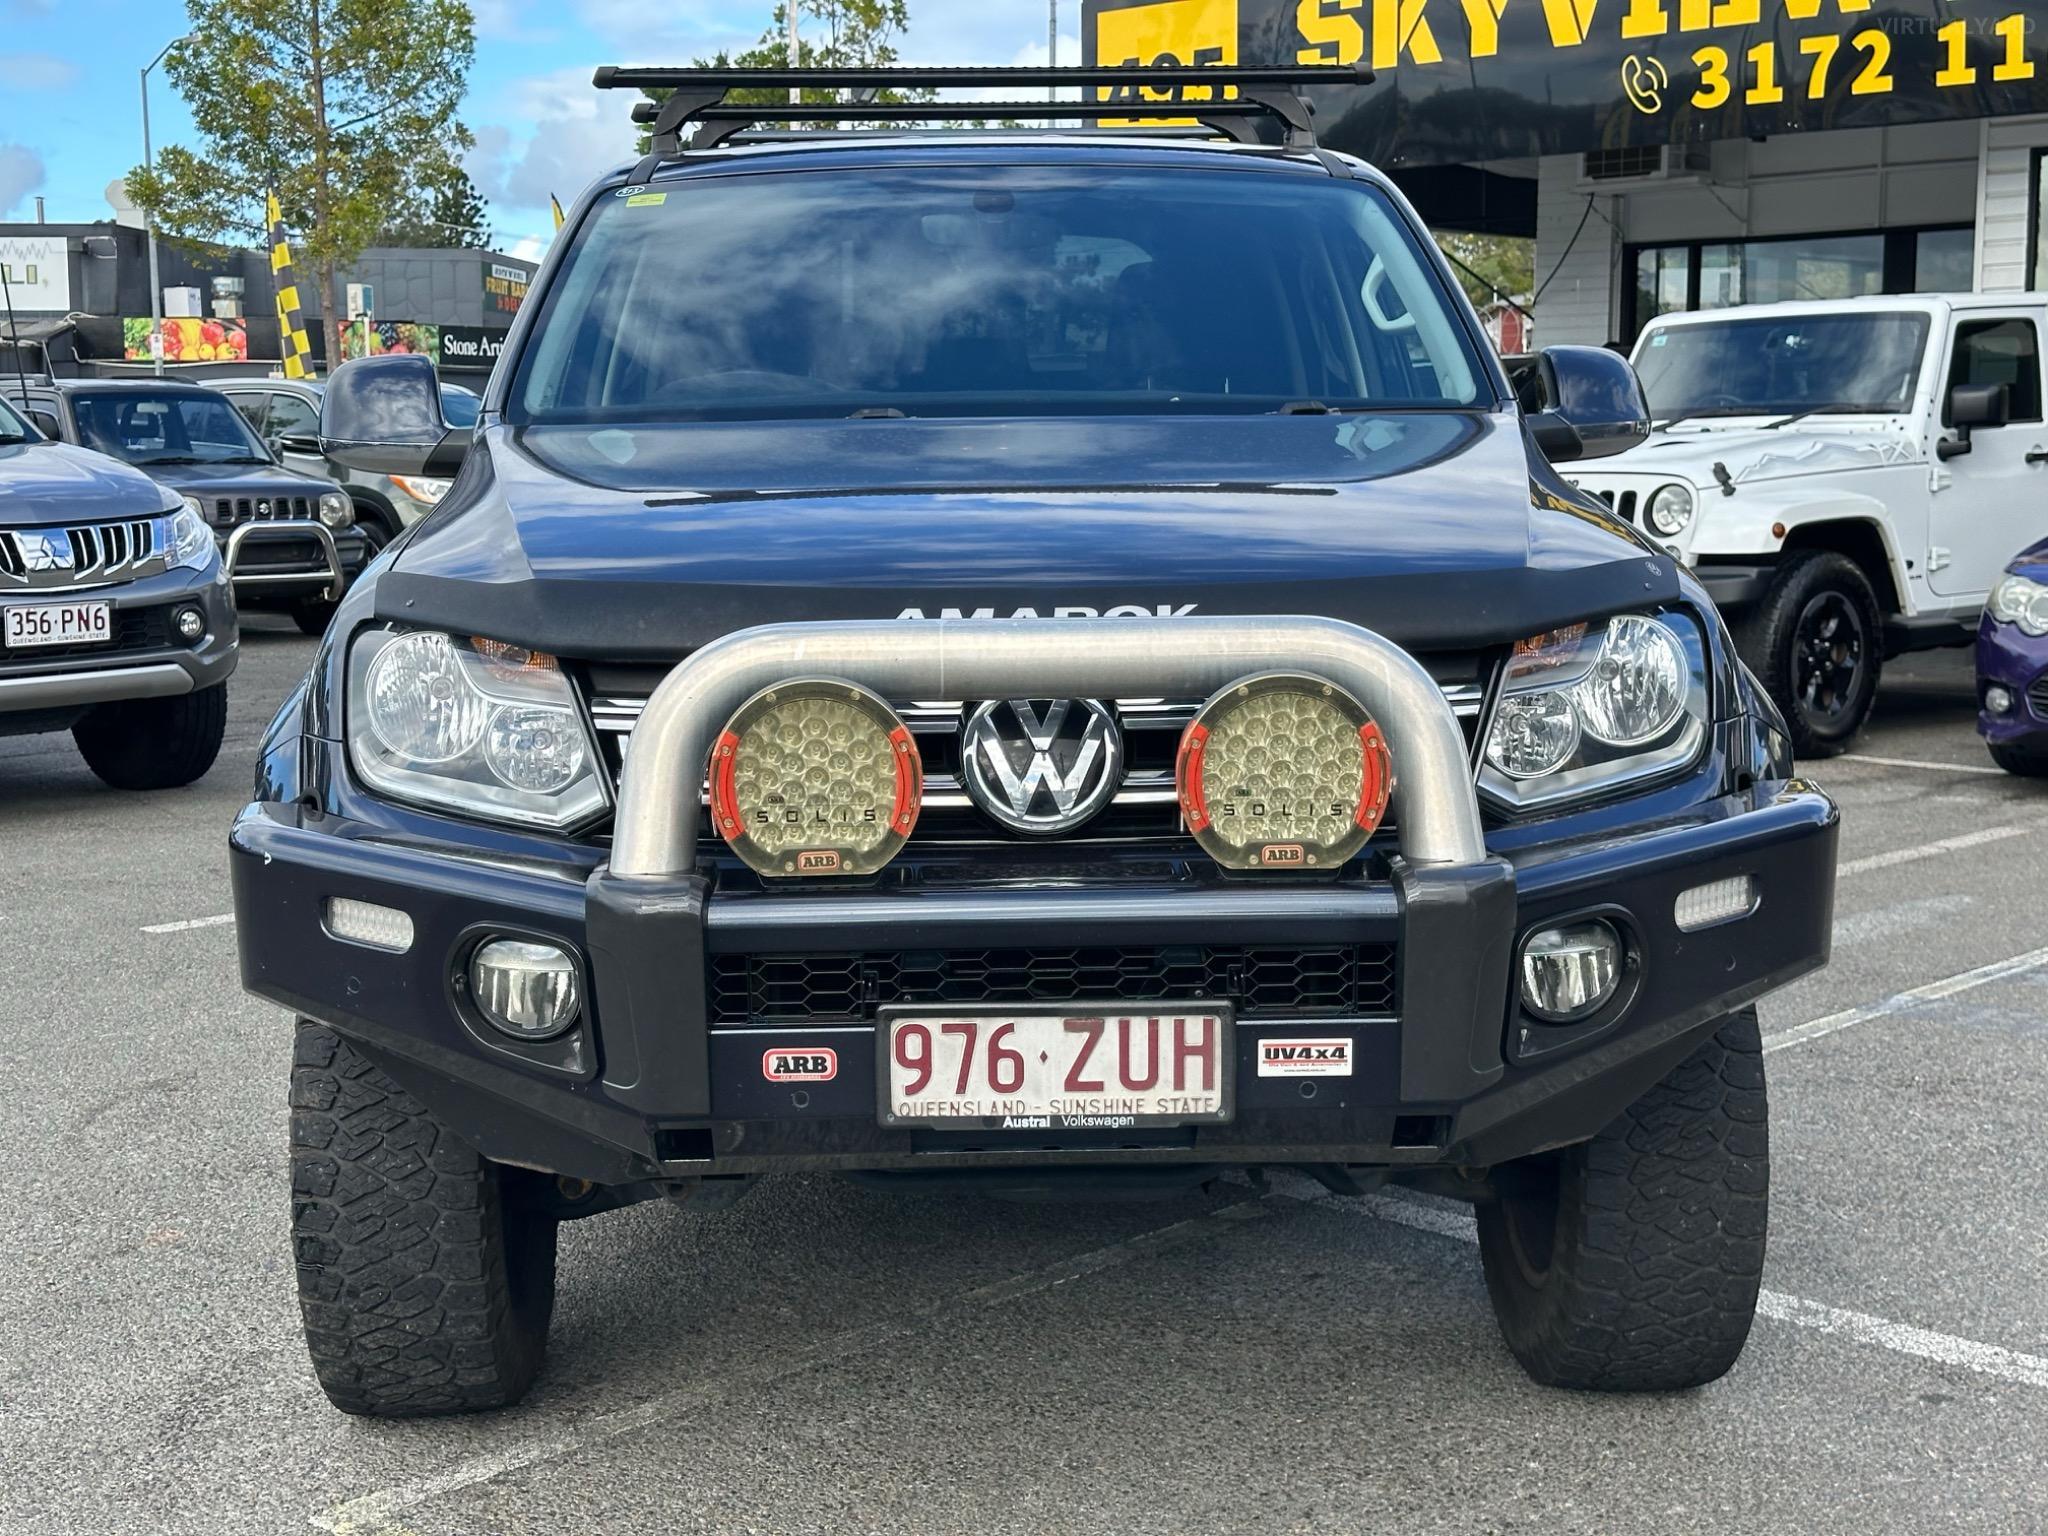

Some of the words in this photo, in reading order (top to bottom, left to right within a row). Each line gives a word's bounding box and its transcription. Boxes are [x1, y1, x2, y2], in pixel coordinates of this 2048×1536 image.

[1296, 0, 1873, 70] SKYVI
[1690, 29, 1894, 109] 3172
[1935, 13, 2035, 87] 11
[443, 334, 478, 356] Stone
[756, 809, 876, 823] SOLIS
[1223, 803, 1342, 816] SOLIS
[803, 855, 835, 868] ARB
[1267, 849, 1299, 861] ARB
[1264, 1046, 1347, 1060] UV4x4
[773, 1055, 828, 1074] ARB
[899, 1100, 1026, 1117] QUEENSLAND
[1050, 1098, 1145, 1114] SUNSHINE
[1156, 1097, 1214, 1114] STATE
[1002, 1115, 1050, 1129] Austral
[1061, 1114, 1134, 1128] Volkswagen
